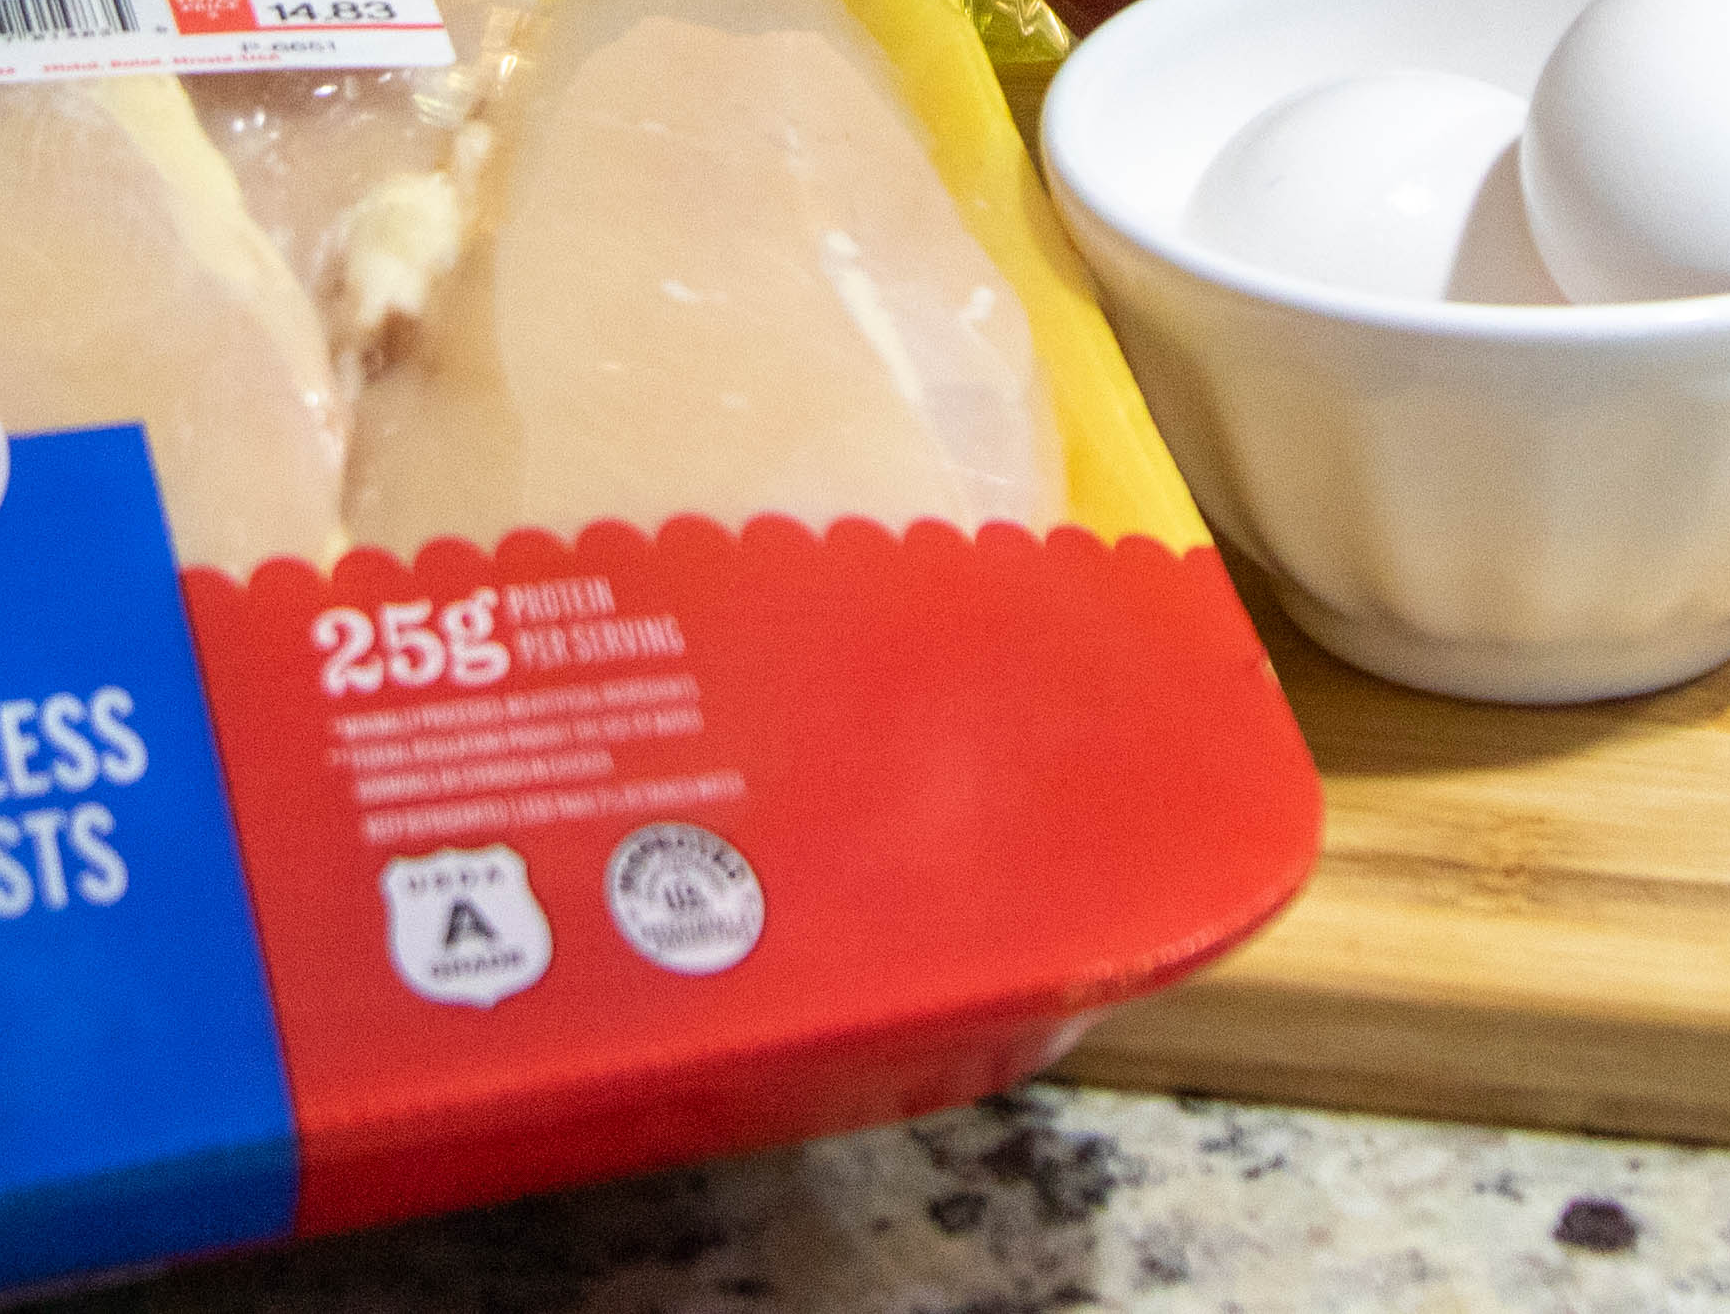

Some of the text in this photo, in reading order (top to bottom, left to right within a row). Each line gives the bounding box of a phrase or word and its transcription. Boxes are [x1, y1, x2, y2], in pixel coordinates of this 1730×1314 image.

[270, 0, 397, 21] 14.83
[504, 576, 616, 620] PROTEIN
[312, 587, 511, 697] 25g
[574, 613, 687, 660] SERVING
[444, 897, 497, 949] A
